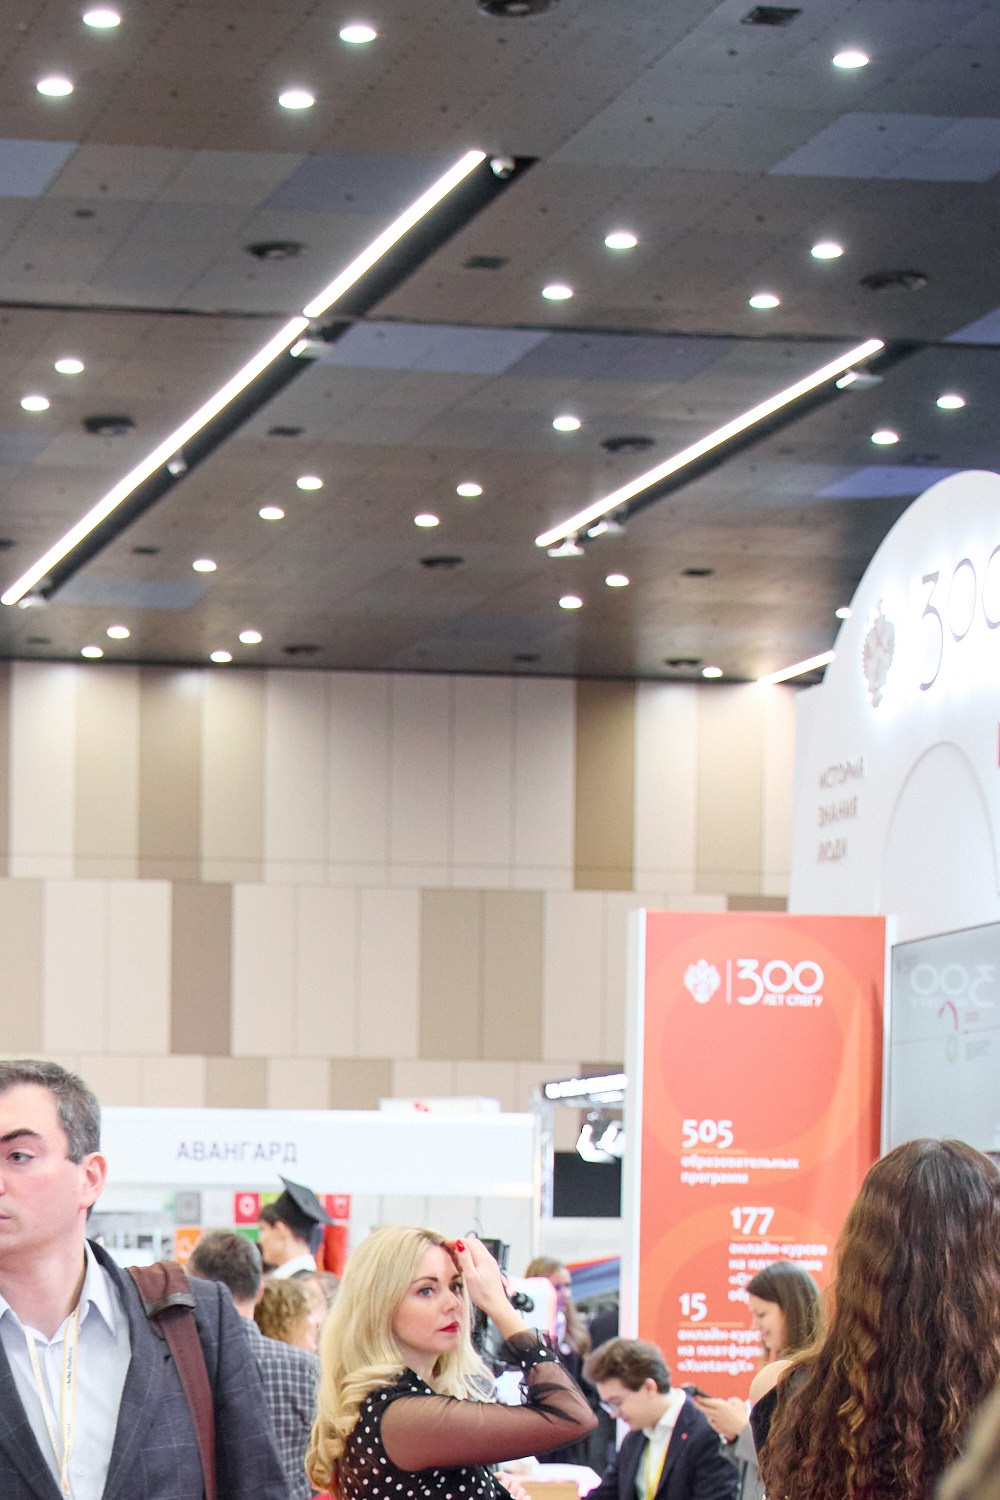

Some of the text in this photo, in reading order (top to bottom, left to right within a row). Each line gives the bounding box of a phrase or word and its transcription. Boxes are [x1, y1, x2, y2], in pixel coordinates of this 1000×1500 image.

[736, 958, 824, 1006] 300
[681, 1119, 735, 1149] 505
[177, 1141, 298, 1164] АВАНГАРД
[680, 1155, 800, 1170] образовательных
[680, 1171, 749, 1187] программ
[730, 1206, 775, 1235] 177
[728, 1241, 828, 1258] онлайн-курсов
[728, 1259, 747, 1270] на
[679, 1292, 707, 1322] 15
[677, 1345, 695, 1357] на
